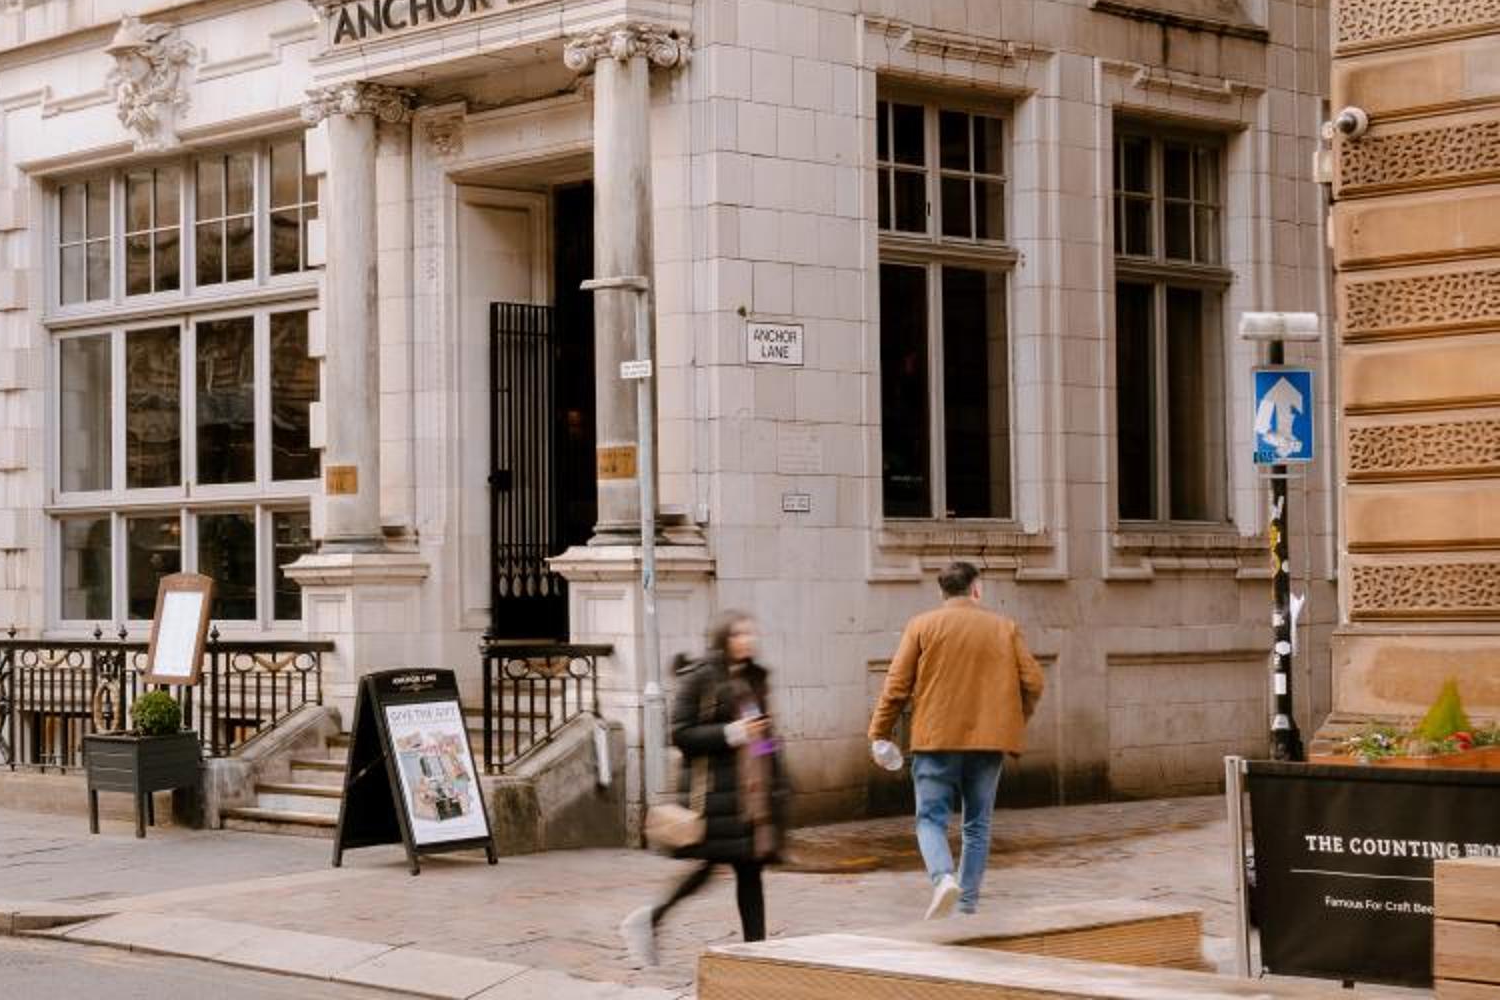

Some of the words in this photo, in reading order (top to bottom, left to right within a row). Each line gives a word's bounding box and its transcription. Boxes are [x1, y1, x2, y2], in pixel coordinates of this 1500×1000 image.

[754, 329, 796, 344] ANCHOR
[761, 345, 789, 358] LANE
[1305, 835, 1344, 853] THE
[1350, 838, 1458, 858] COUNTING
[1325, 896, 1363, 909] Famous
[1365, 899, 1382, 911] For
[1385, 901, 1411, 913] Craft
